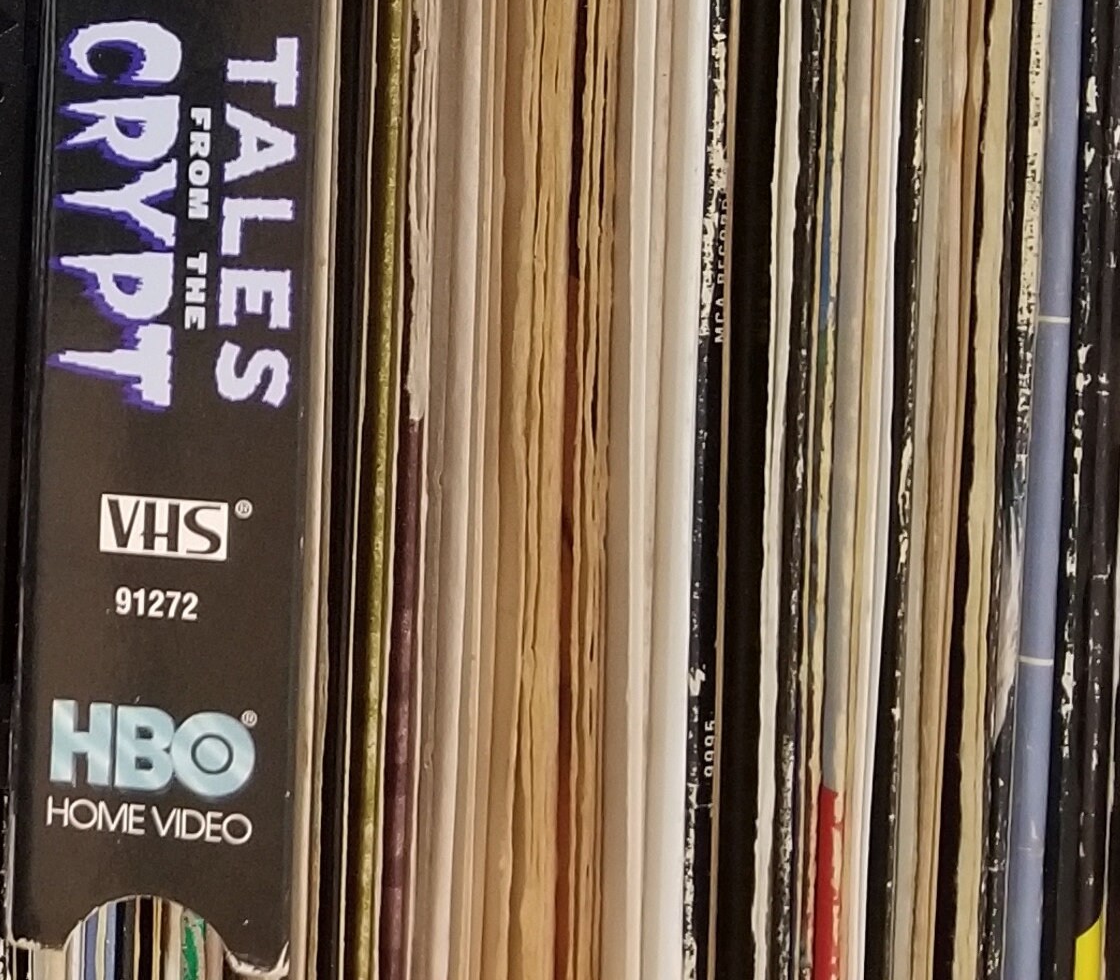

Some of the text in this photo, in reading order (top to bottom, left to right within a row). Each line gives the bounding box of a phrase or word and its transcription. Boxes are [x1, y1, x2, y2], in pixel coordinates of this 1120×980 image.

[48, 19, 182, 411] CRYPT
[184, 106, 212, 331] FROM THE
[215, 36, 300, 409] TALES
[106, 498, 223, 556] VHS
[115, 586, 199, 621] 91272
[50, 699, 256, 798] HBO
[46, 796, 252, 845] HOME VIDEO
